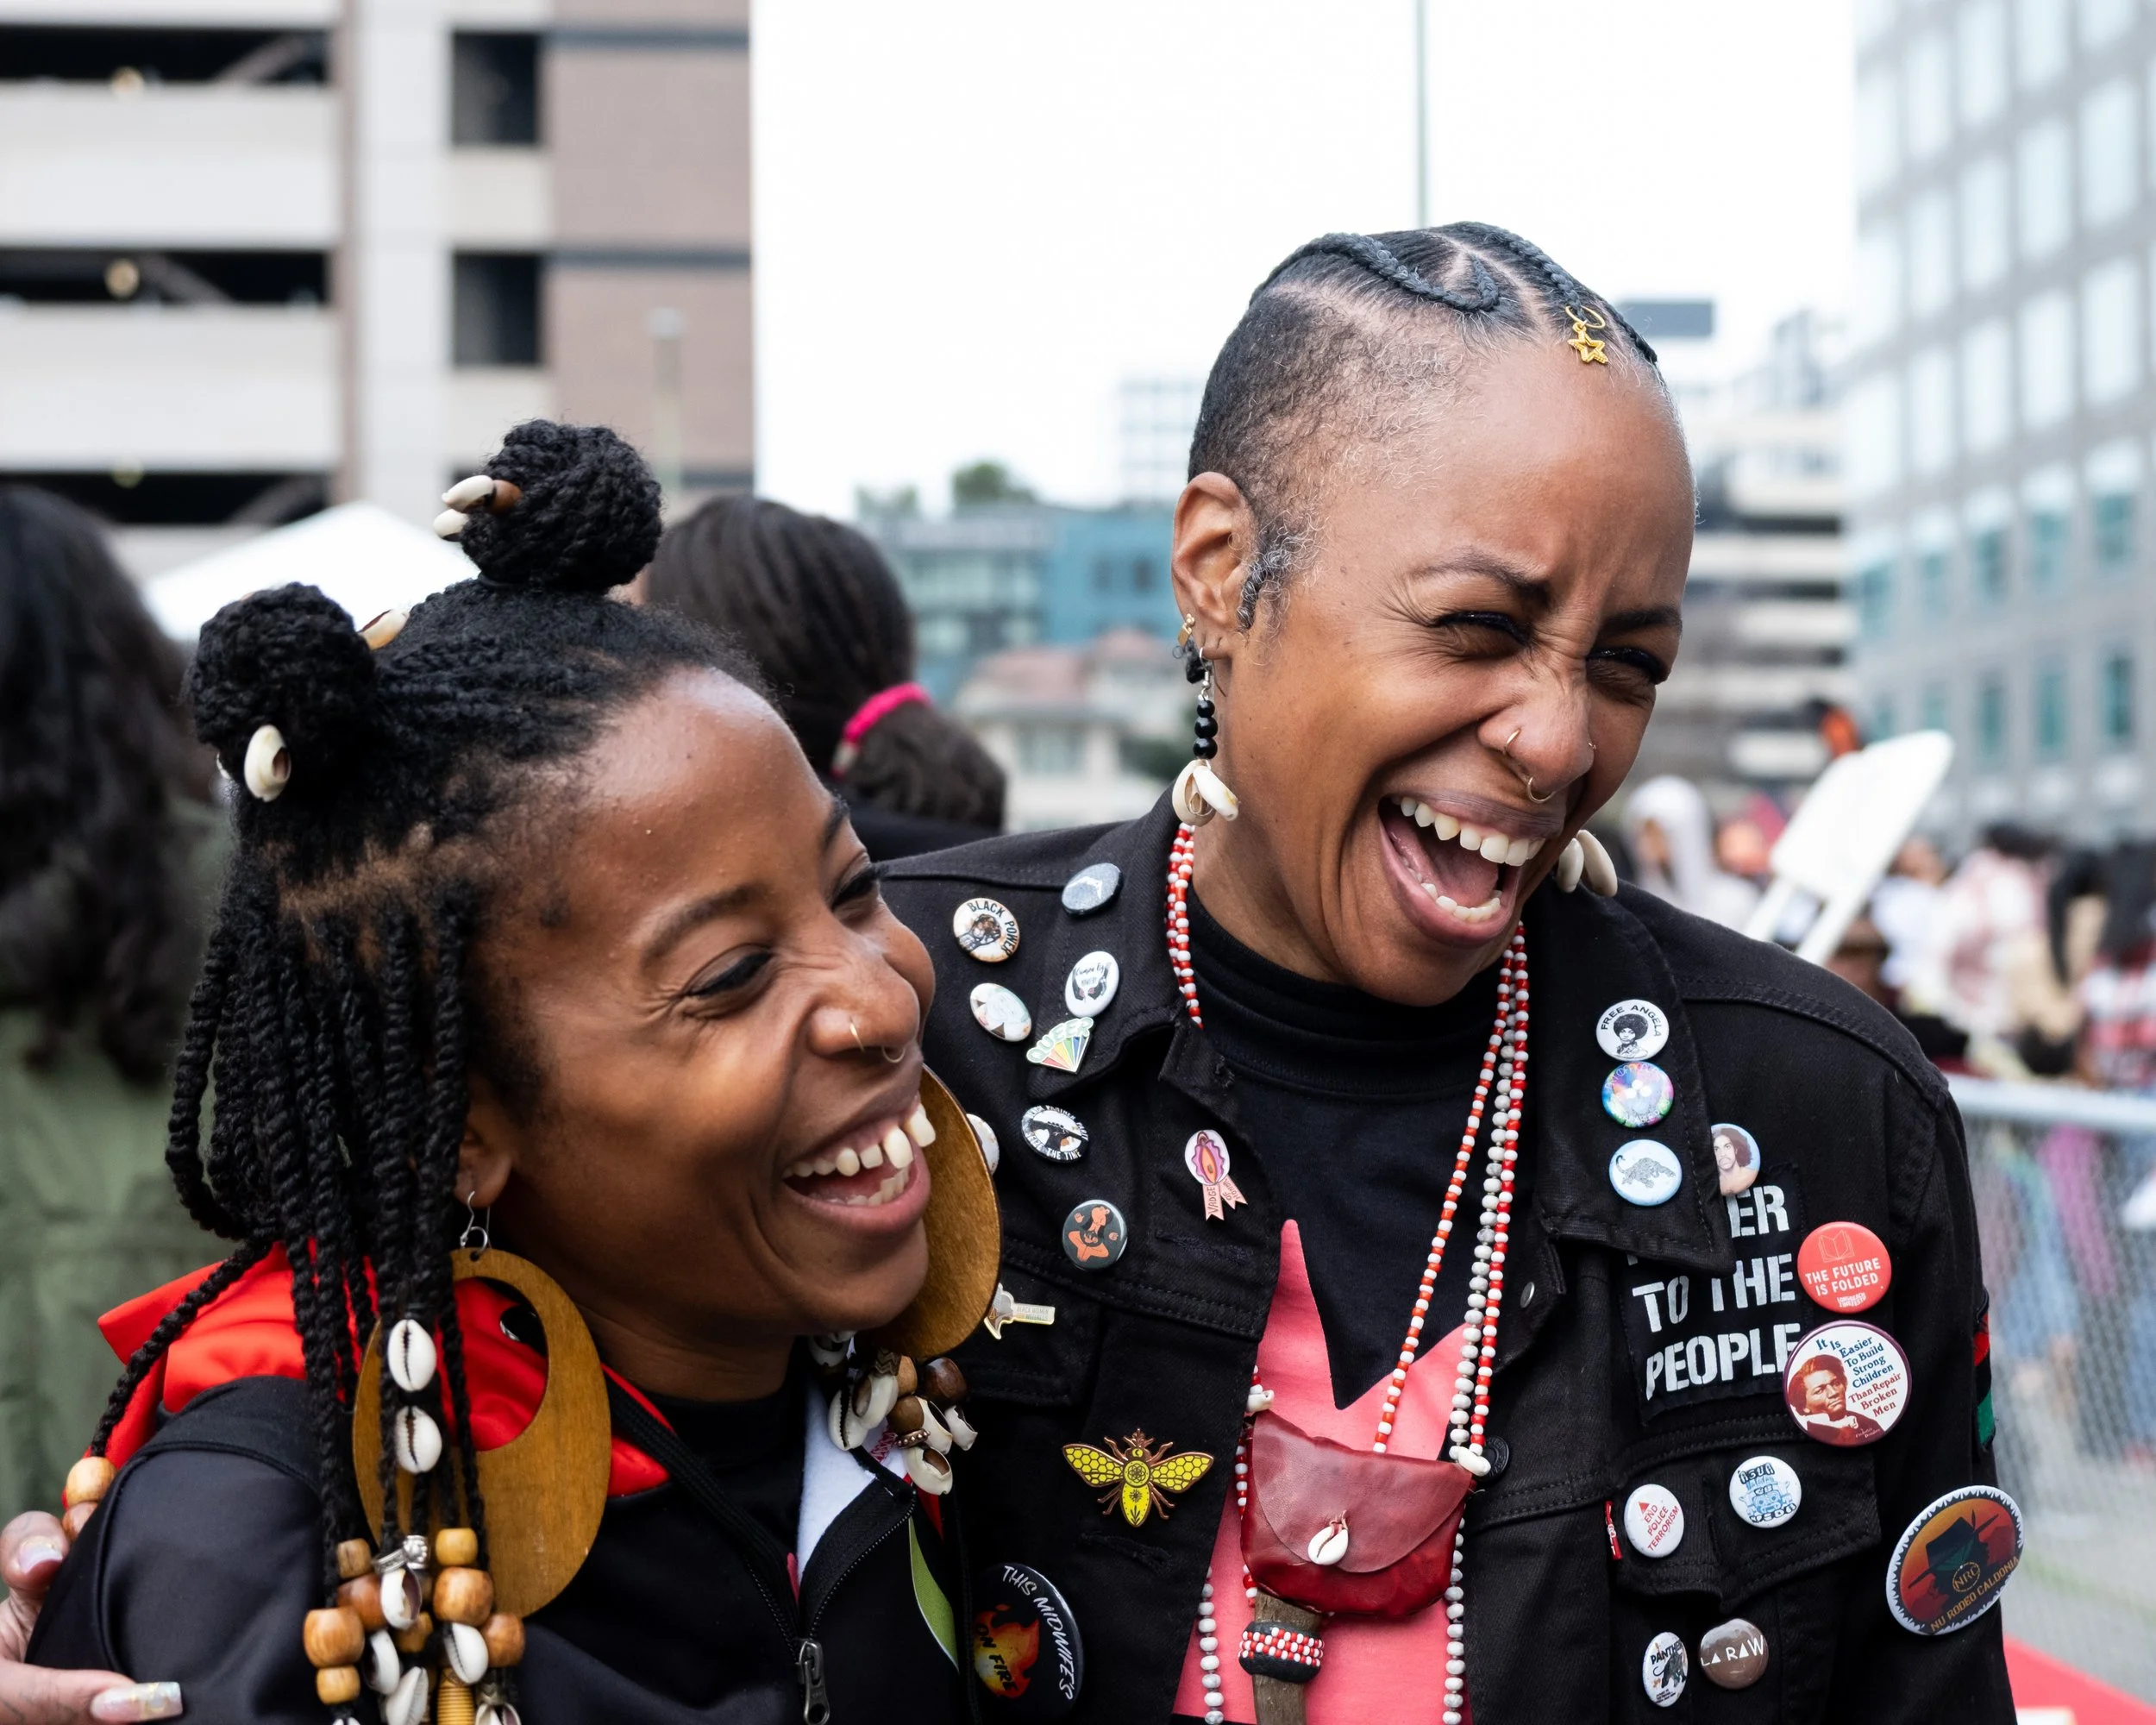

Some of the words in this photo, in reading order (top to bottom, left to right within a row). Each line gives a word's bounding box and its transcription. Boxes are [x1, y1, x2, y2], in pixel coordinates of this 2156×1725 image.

[967, 900, 1005, 917] BLACK
[1001, 921, 1018, 957] POWER
[1601, 1006, 1625, 1030] FREE
[1631, 1005, 1662, 1037] ANGELA
[1047, 1148, 1061, 1160] THE
[1065, 1149, 1081, 1161] TIME
[1207, 1186, 1219, 1214] VADGE
[1222, 1191, 1232, 1201] OF
[1805, 1270, 1829, 1284] THE
[1833, 1258, 1881, 1278] FUTURE
[1815, 1284, 1828, 1296] IS
[1831, 1272, 1878, 1293] FOLDED
[1632, 1276, 1689, 1333] TO
[1815, 1339, 1827, 1351] It
[1830, 1340, 1841, 1351] Is
[1839, 1337, 1872, 1358] Easier
[1844, 1357, 1858, 1368] To
[1858, 1343, 1884, 1360] Build
[1645, 1323, 1801, 1401] PEOPLE
[1852, 1356, 1886, 1376] Strong
[1848, 1388, 1872, 1403] Than
[1872, 1373, 1902, 1392] Repair
[1852, 1364, 1894, 1389] Children
[1860, 1388, 1897, 1410] Broken
[1872, 1401, 1896, 1417] Men
[1644, 1505, 1658, 1523] END
[1647, 1506, 1668, 1536] POLICE
[1647, 1505, 1679, 1551] TERRORISM
[1954, 1566, 1978, 1589] NRC
[1930, 1617, 1946, 1632] NU
[1946, 1593, 1977, 1619] RODEO
[1977, 1556, 2019, 1595] CALDONIA
[1003, 1565, 1037, 1596] THIS
[1033, 1597, 1075, 1700] MIDWIFE'S
[977, 1625, 997, 1648] ON
[988, 1653, 1019, 1692] FIRE
